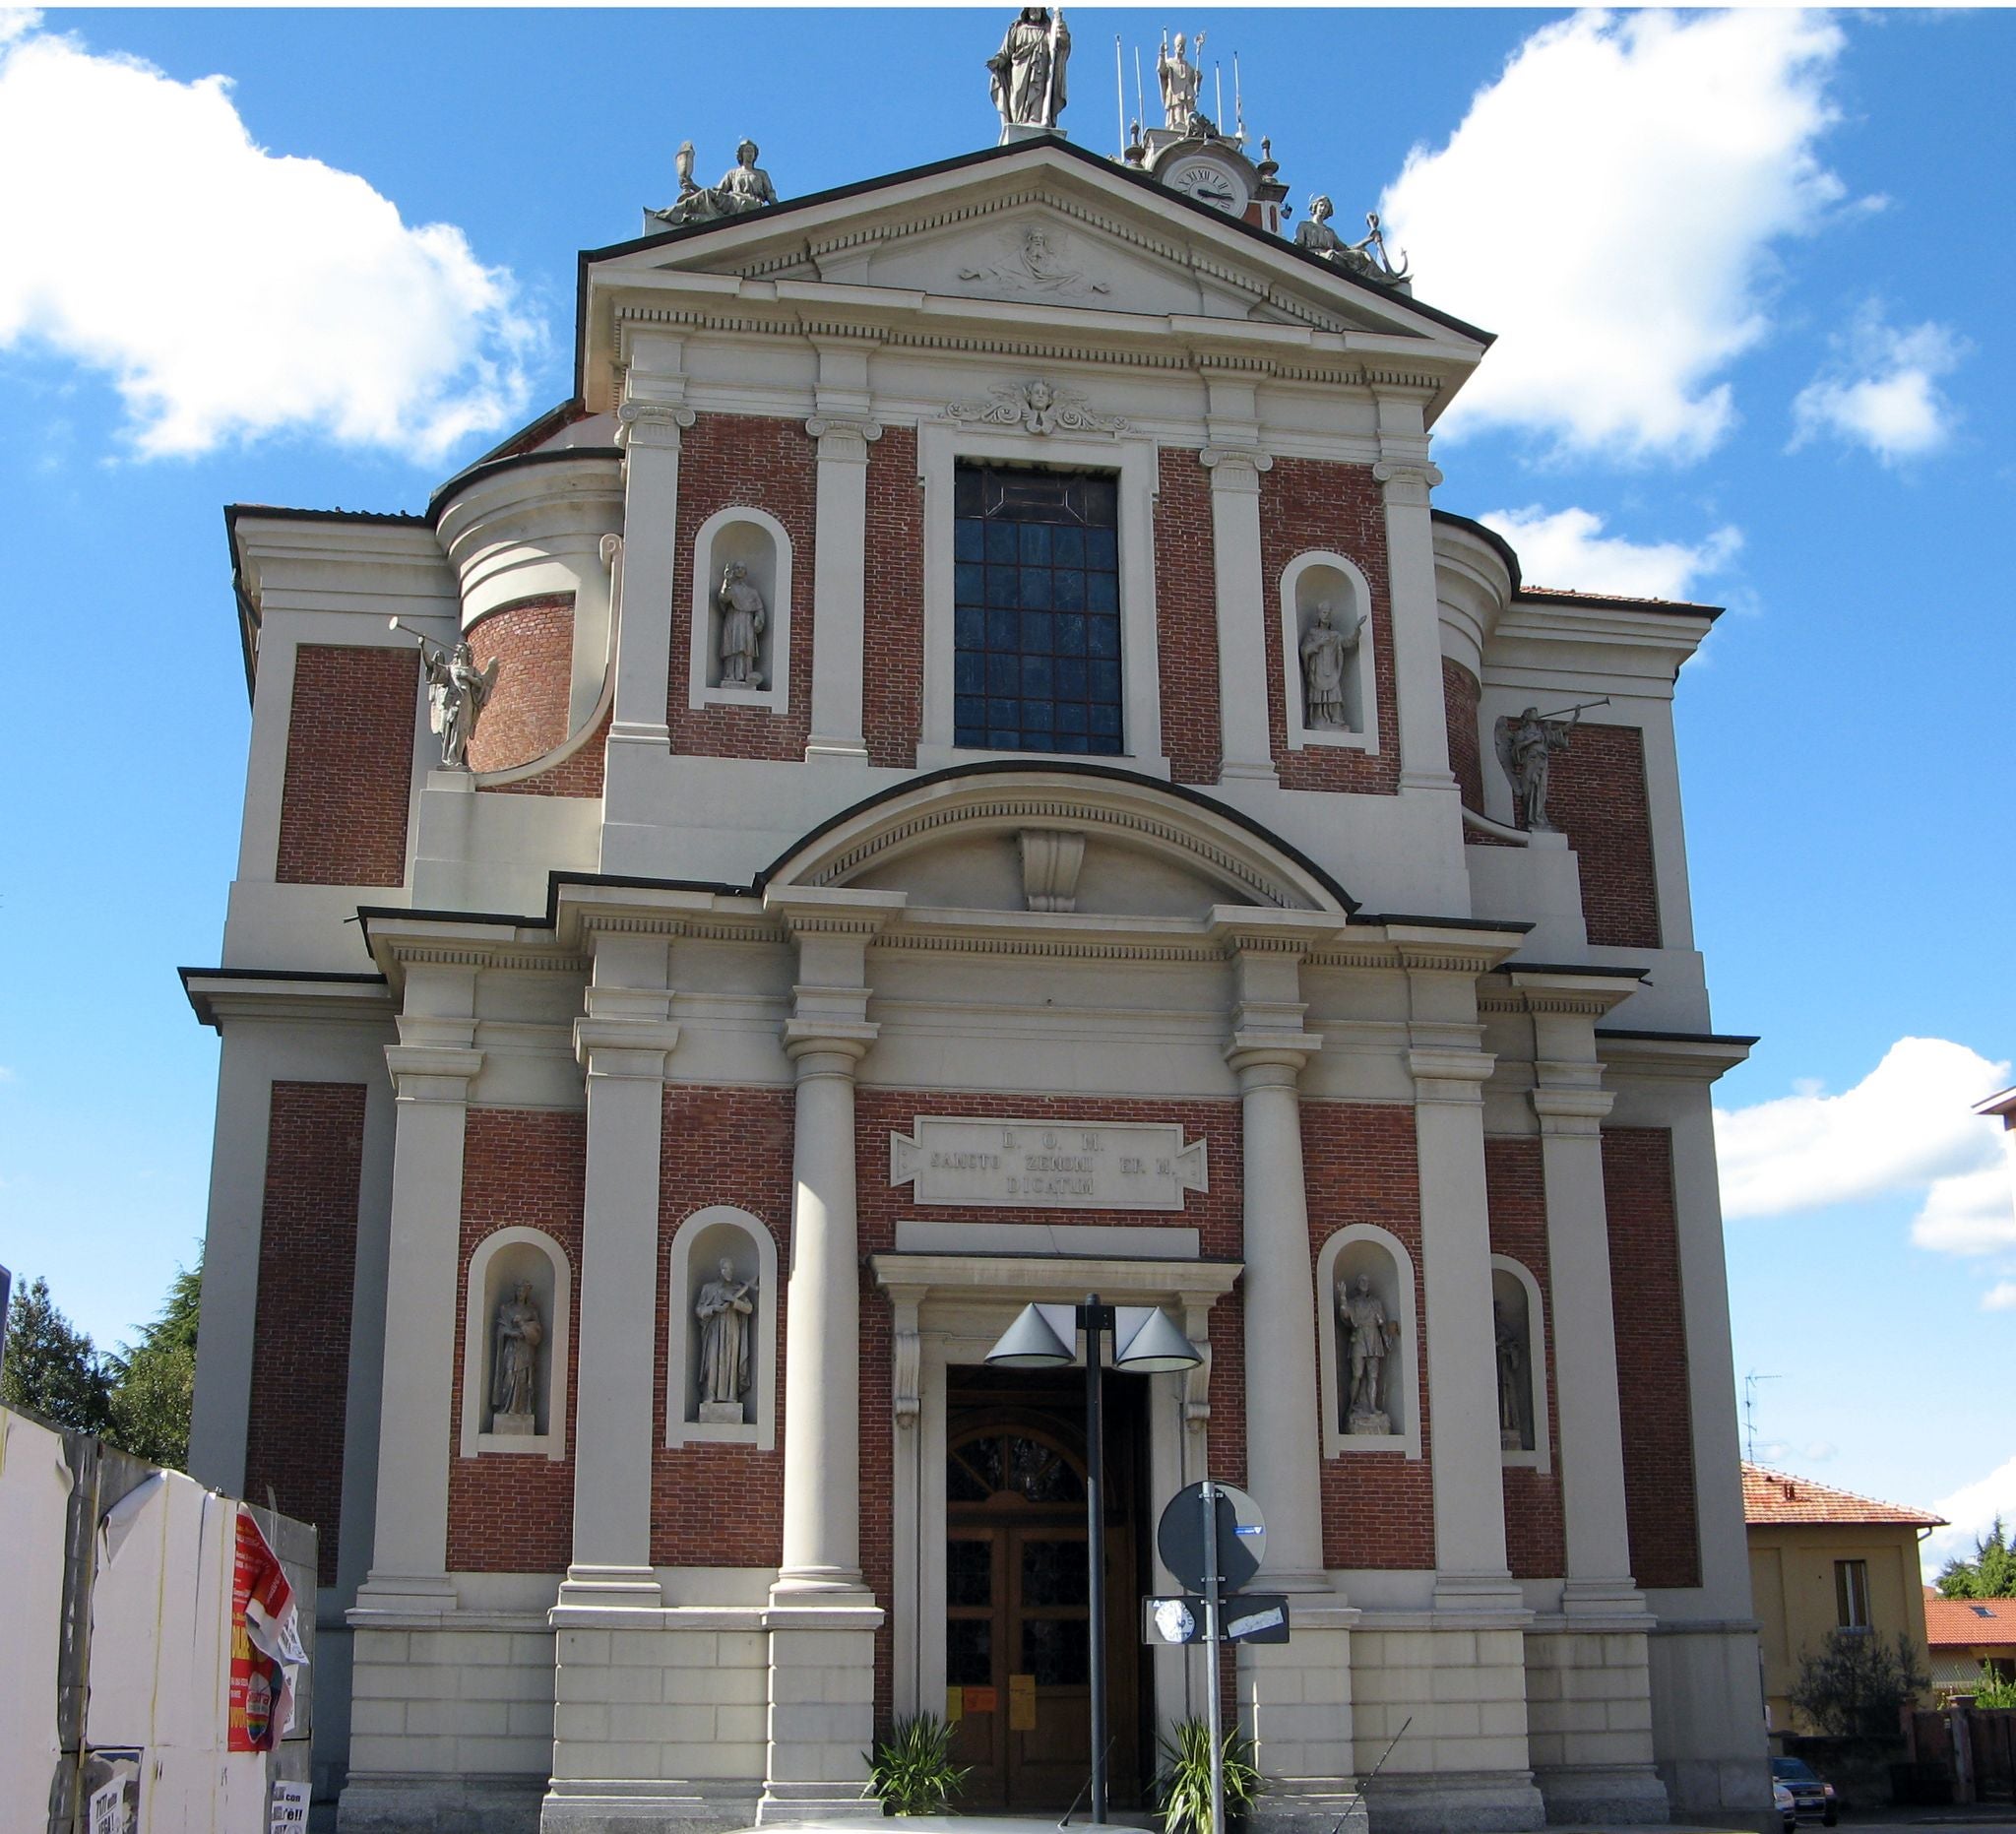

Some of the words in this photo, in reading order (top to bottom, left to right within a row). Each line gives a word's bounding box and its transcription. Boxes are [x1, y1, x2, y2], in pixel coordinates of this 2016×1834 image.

[929, 1152, 1001, 1170] SANCTO
[1025, 1155, 1094, 1172] ZENONI
[1119, 1157, 1146, 1174] EP.
[1007, 1177, 1095, 1195] DICATUM
